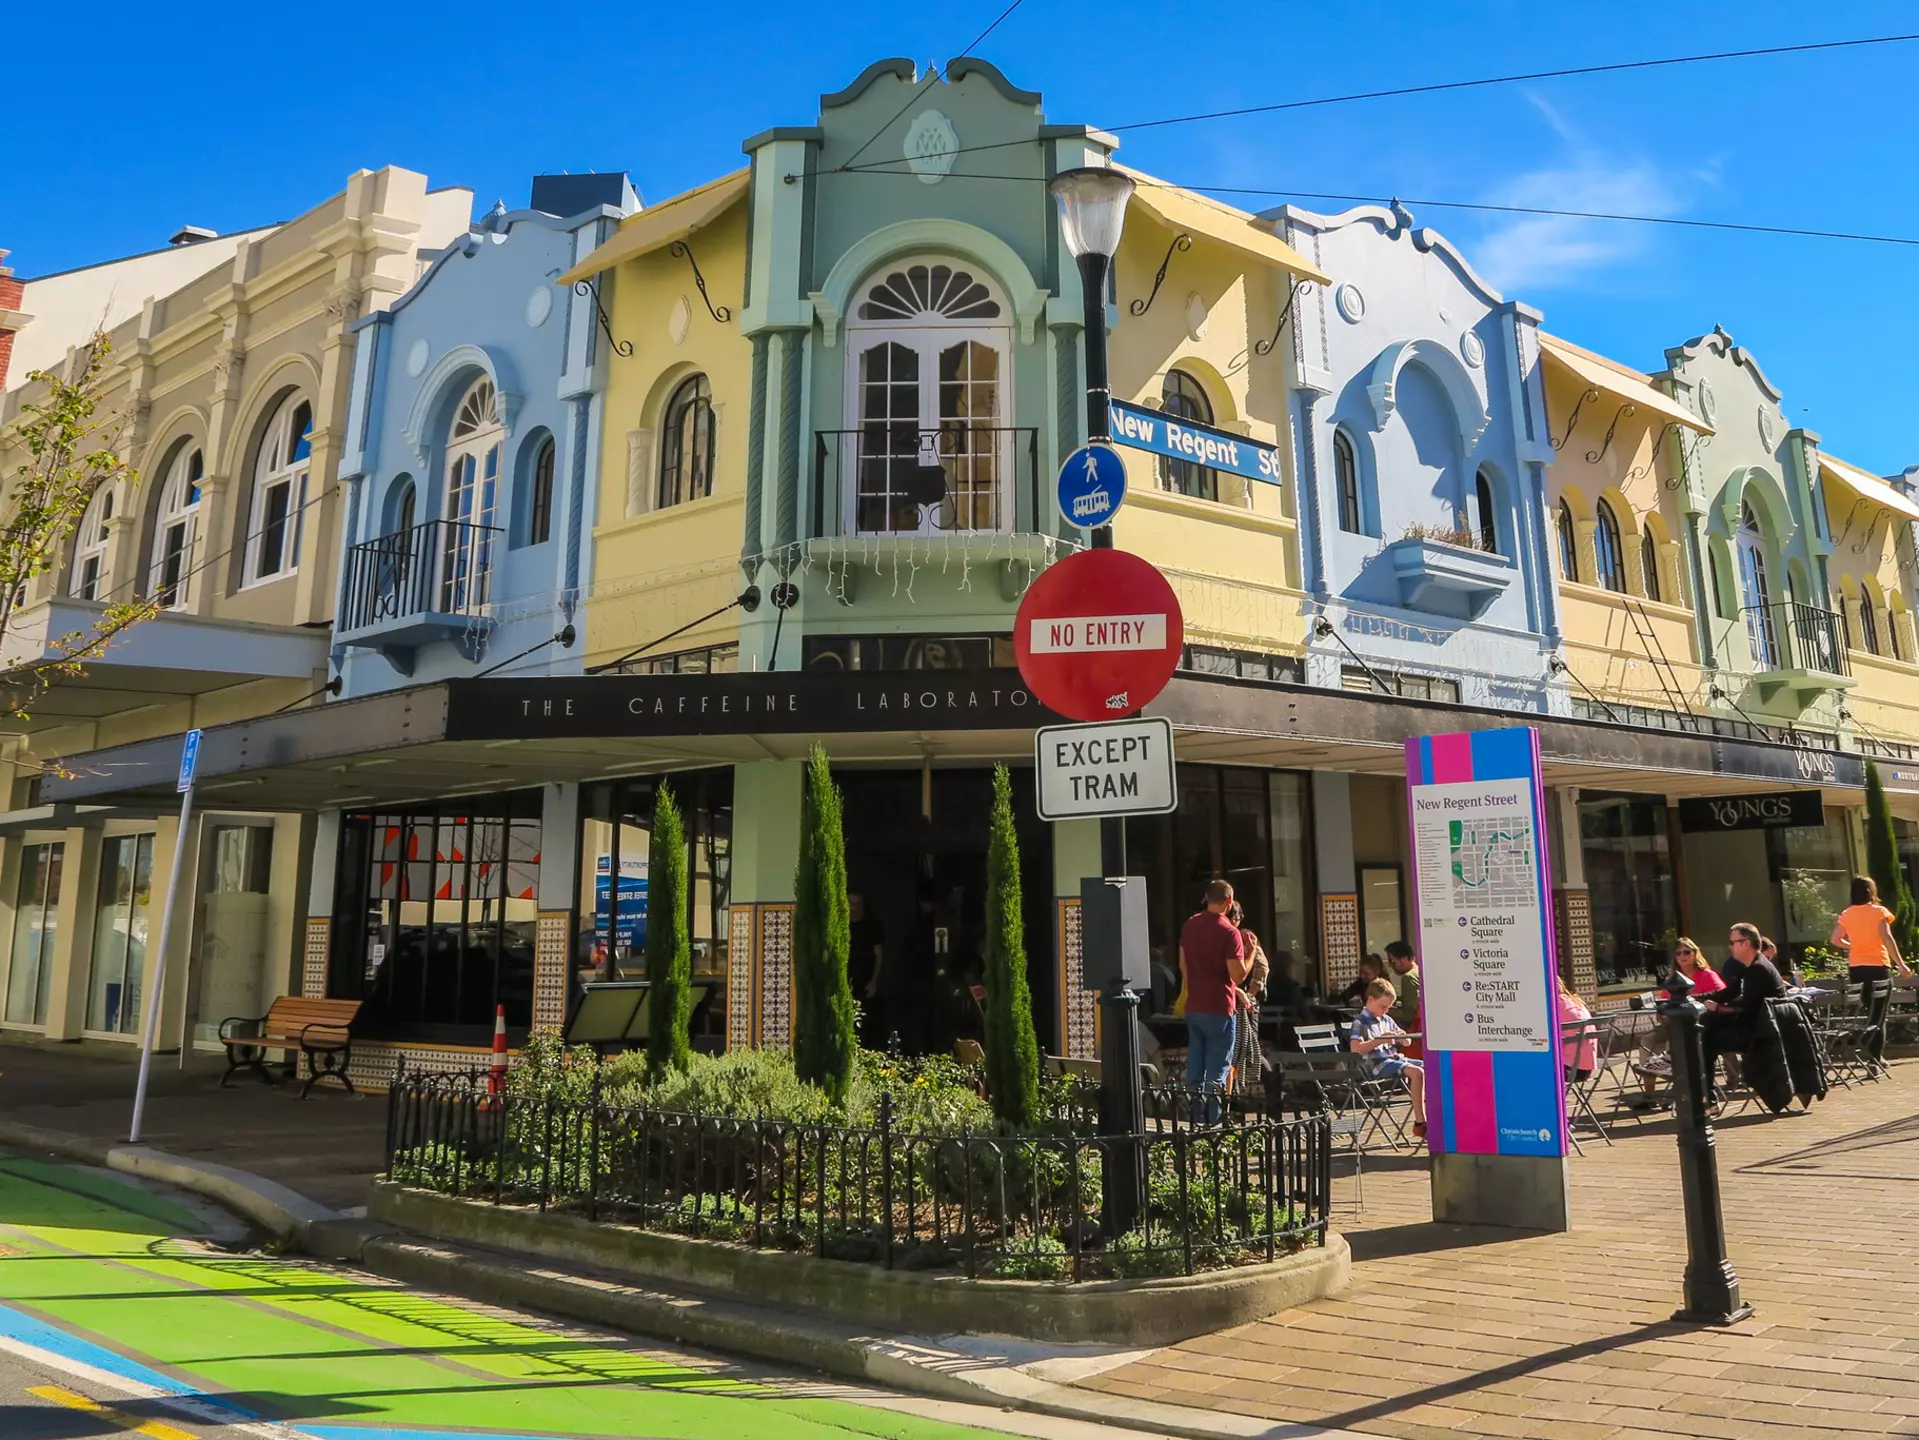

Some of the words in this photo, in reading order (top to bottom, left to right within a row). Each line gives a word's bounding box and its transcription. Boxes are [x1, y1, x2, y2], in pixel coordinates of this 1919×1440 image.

[1111, 407, 1154, 443] New
[1166, 422, 1239, 467] Regent
[1258, 449, 1281, 478] St
[1050, 624, 1074, 647] NO
[1086, 621, 1145, 646] ENTRY
[522, 699, 574, 716] THE
[628, 695, 797, 714] CAFFEINE
[857, 690, 1043, 709] LABORATO
[1056, 735, 1151, 767] EXCEPT
[1794, 750, 1836, 778] YOUNGS
[1069, 771, 1139, 801] TRAM
[1416, 799, 1441, 811] New
[1443, 797, 1482, 811] Regent
[1484, 794, 1518, 806] Street
[1709, 797, 1792, 826] YOUNGS
[1470, 915, 1515, 926] Cathedral
[1471, 927, 1503, 939] Square
[1473, 947, 1508, 958] Victoria
[1473, 959, 1505, 971] Square
[1475, 981, 1520, 991] Re:START
[1475, 992, 1494, 1004] City
[1495, 992, 1516, 1002] Mall
[1477, 1013, 1495, 1024] Bus
[1478, 1025, 1533, 1037] Interchange
